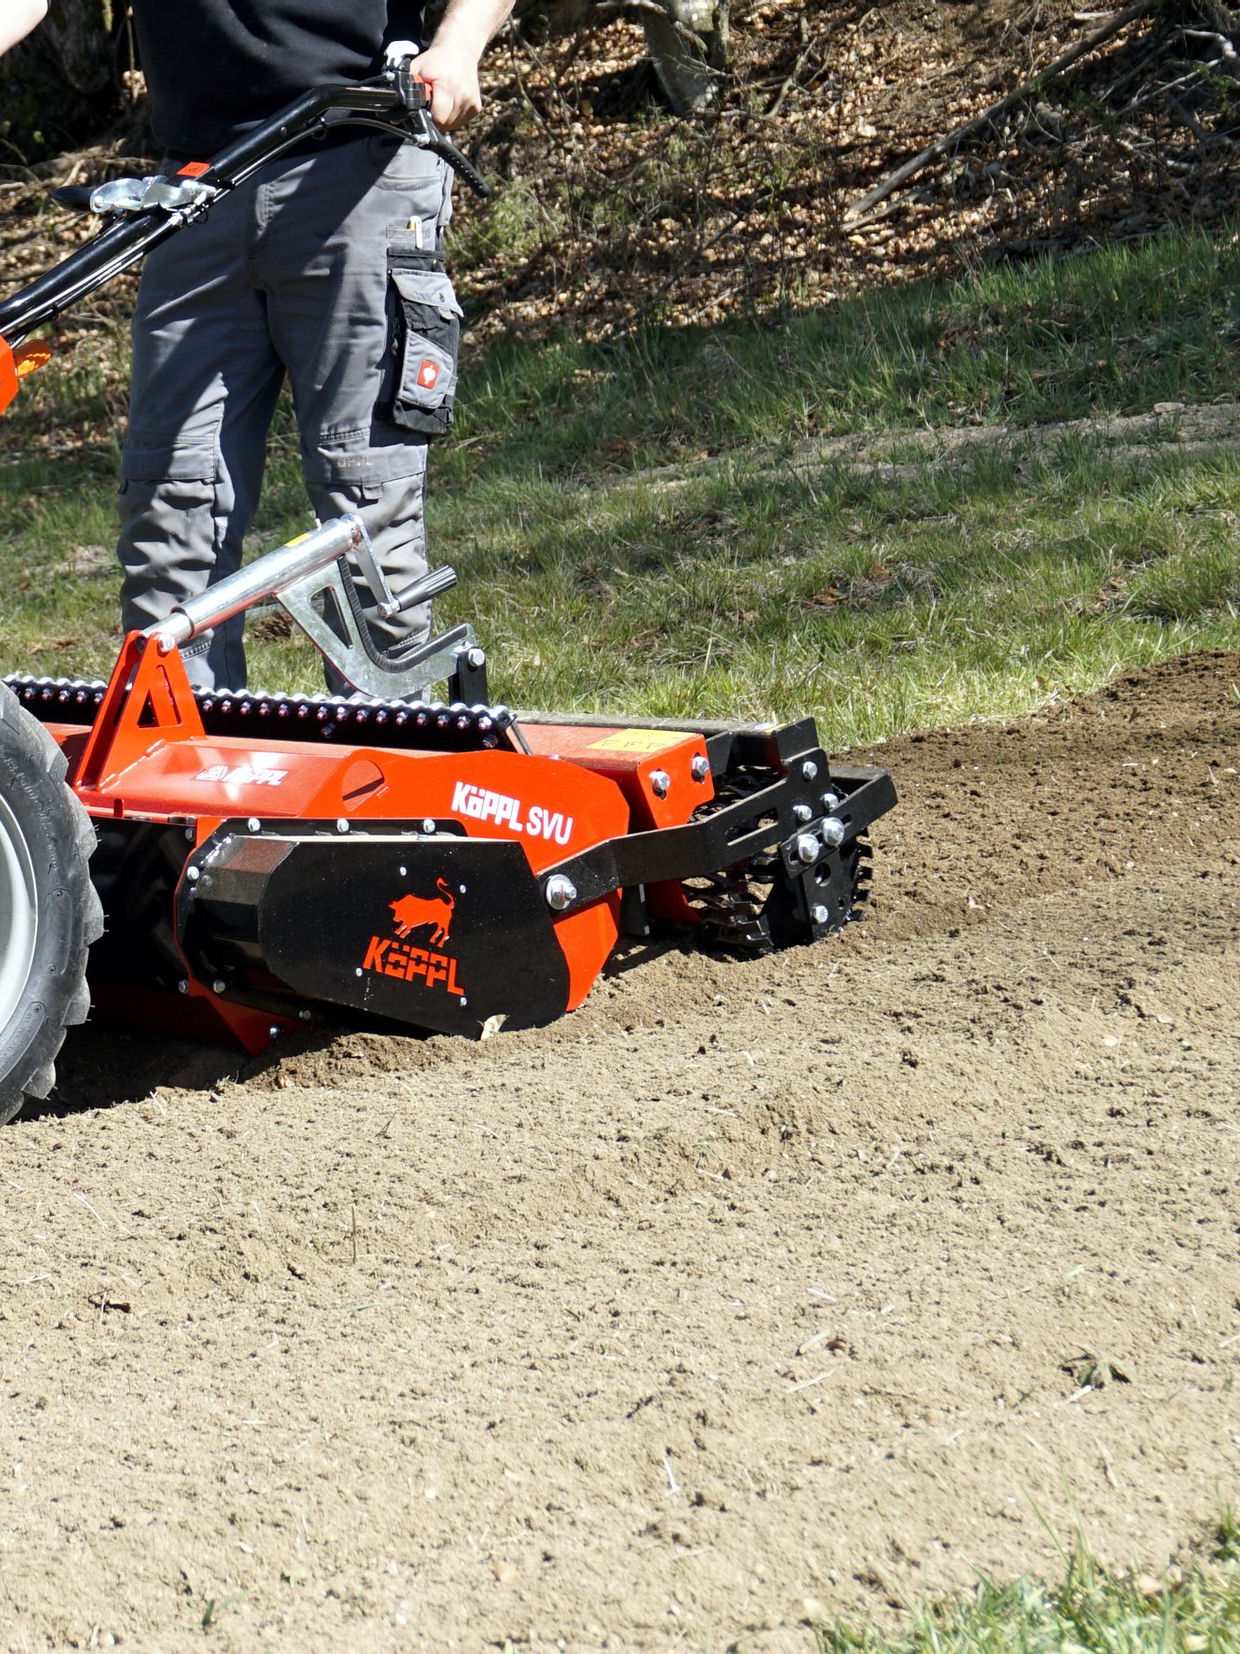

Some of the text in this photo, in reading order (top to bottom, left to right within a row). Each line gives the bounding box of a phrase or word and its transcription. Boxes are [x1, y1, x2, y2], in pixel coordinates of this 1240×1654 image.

[451, 781, 574, 845] KÖPPL SVU
[362, 935, 466, 996] KÖPPL
